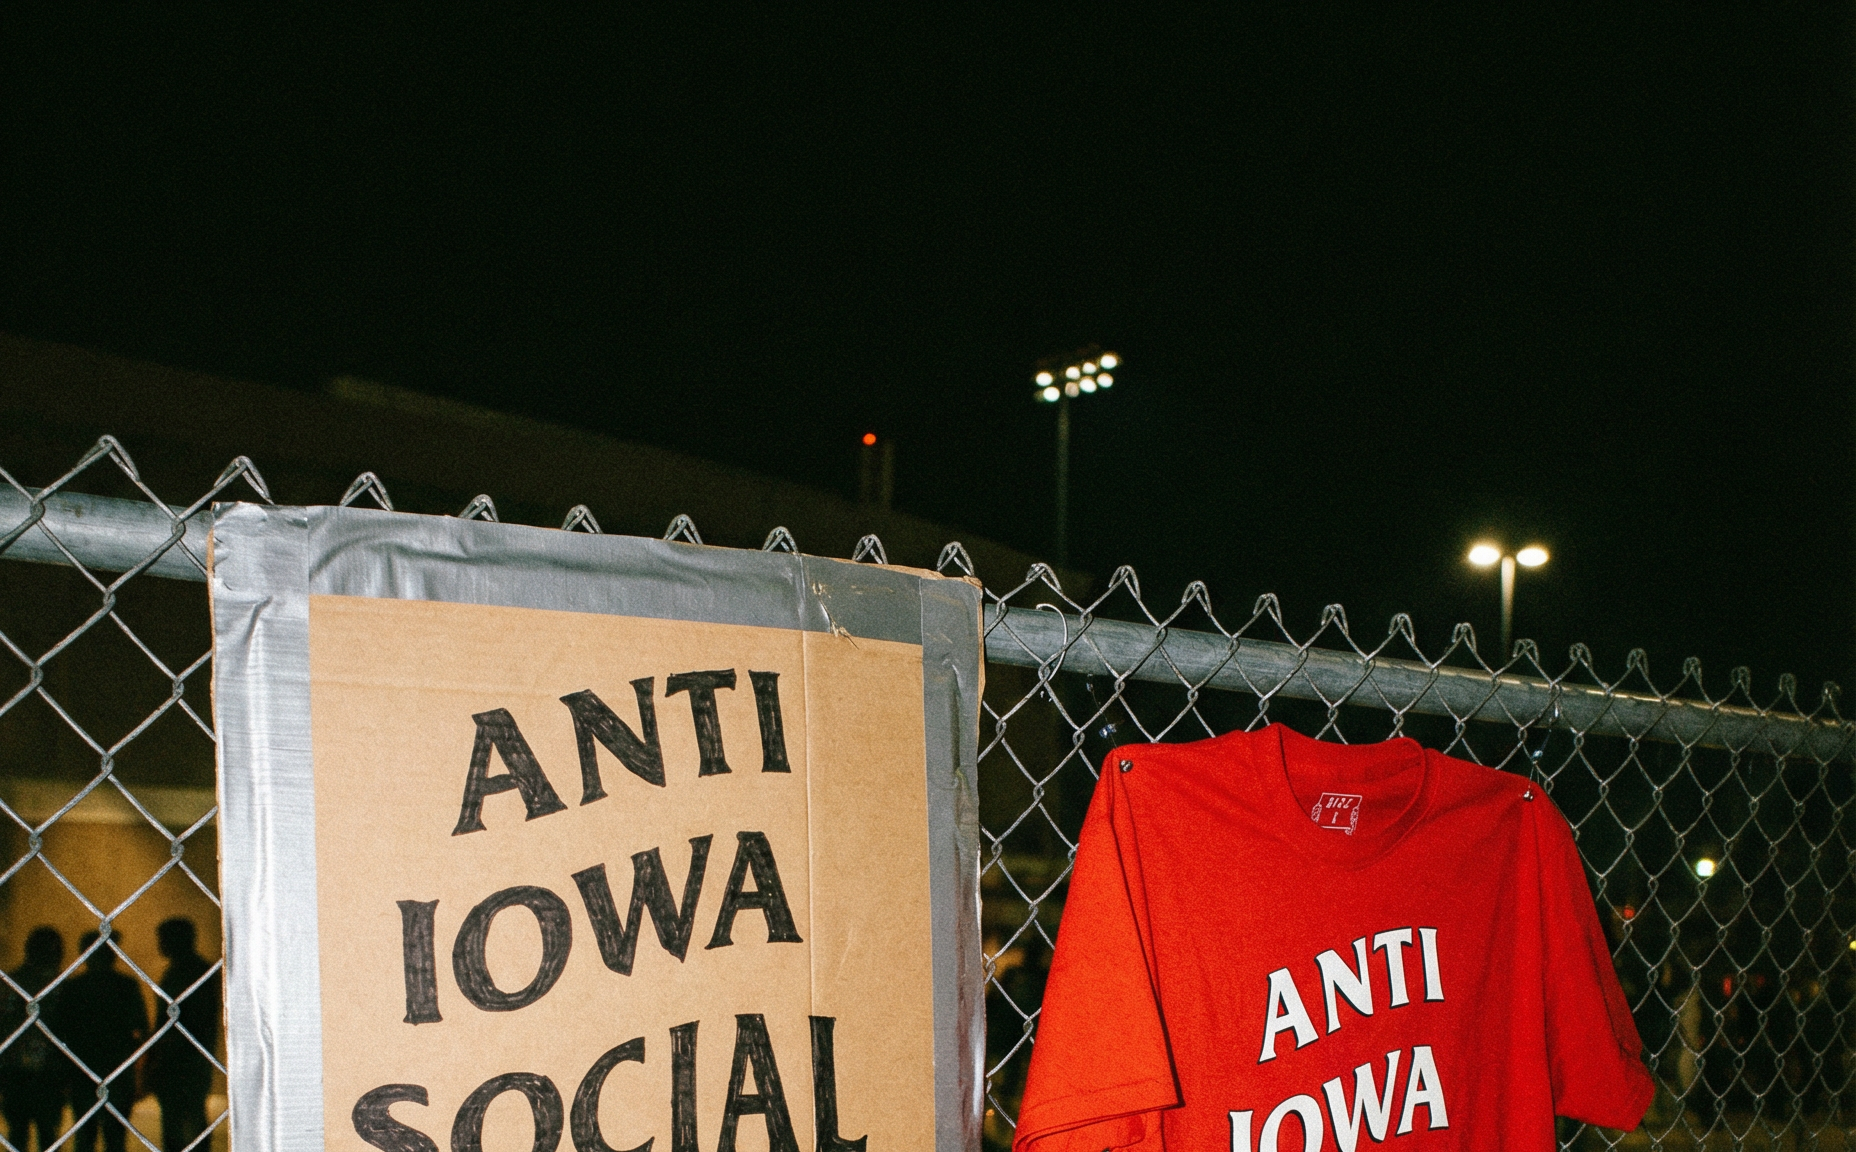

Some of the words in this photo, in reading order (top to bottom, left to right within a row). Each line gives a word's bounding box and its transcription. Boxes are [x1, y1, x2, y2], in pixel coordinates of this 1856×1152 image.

[451, 668, 792, 837] ANTI
[396, 831, 804, 1026] IOWA
[1257, 926, 1446, 1065] ANTI
